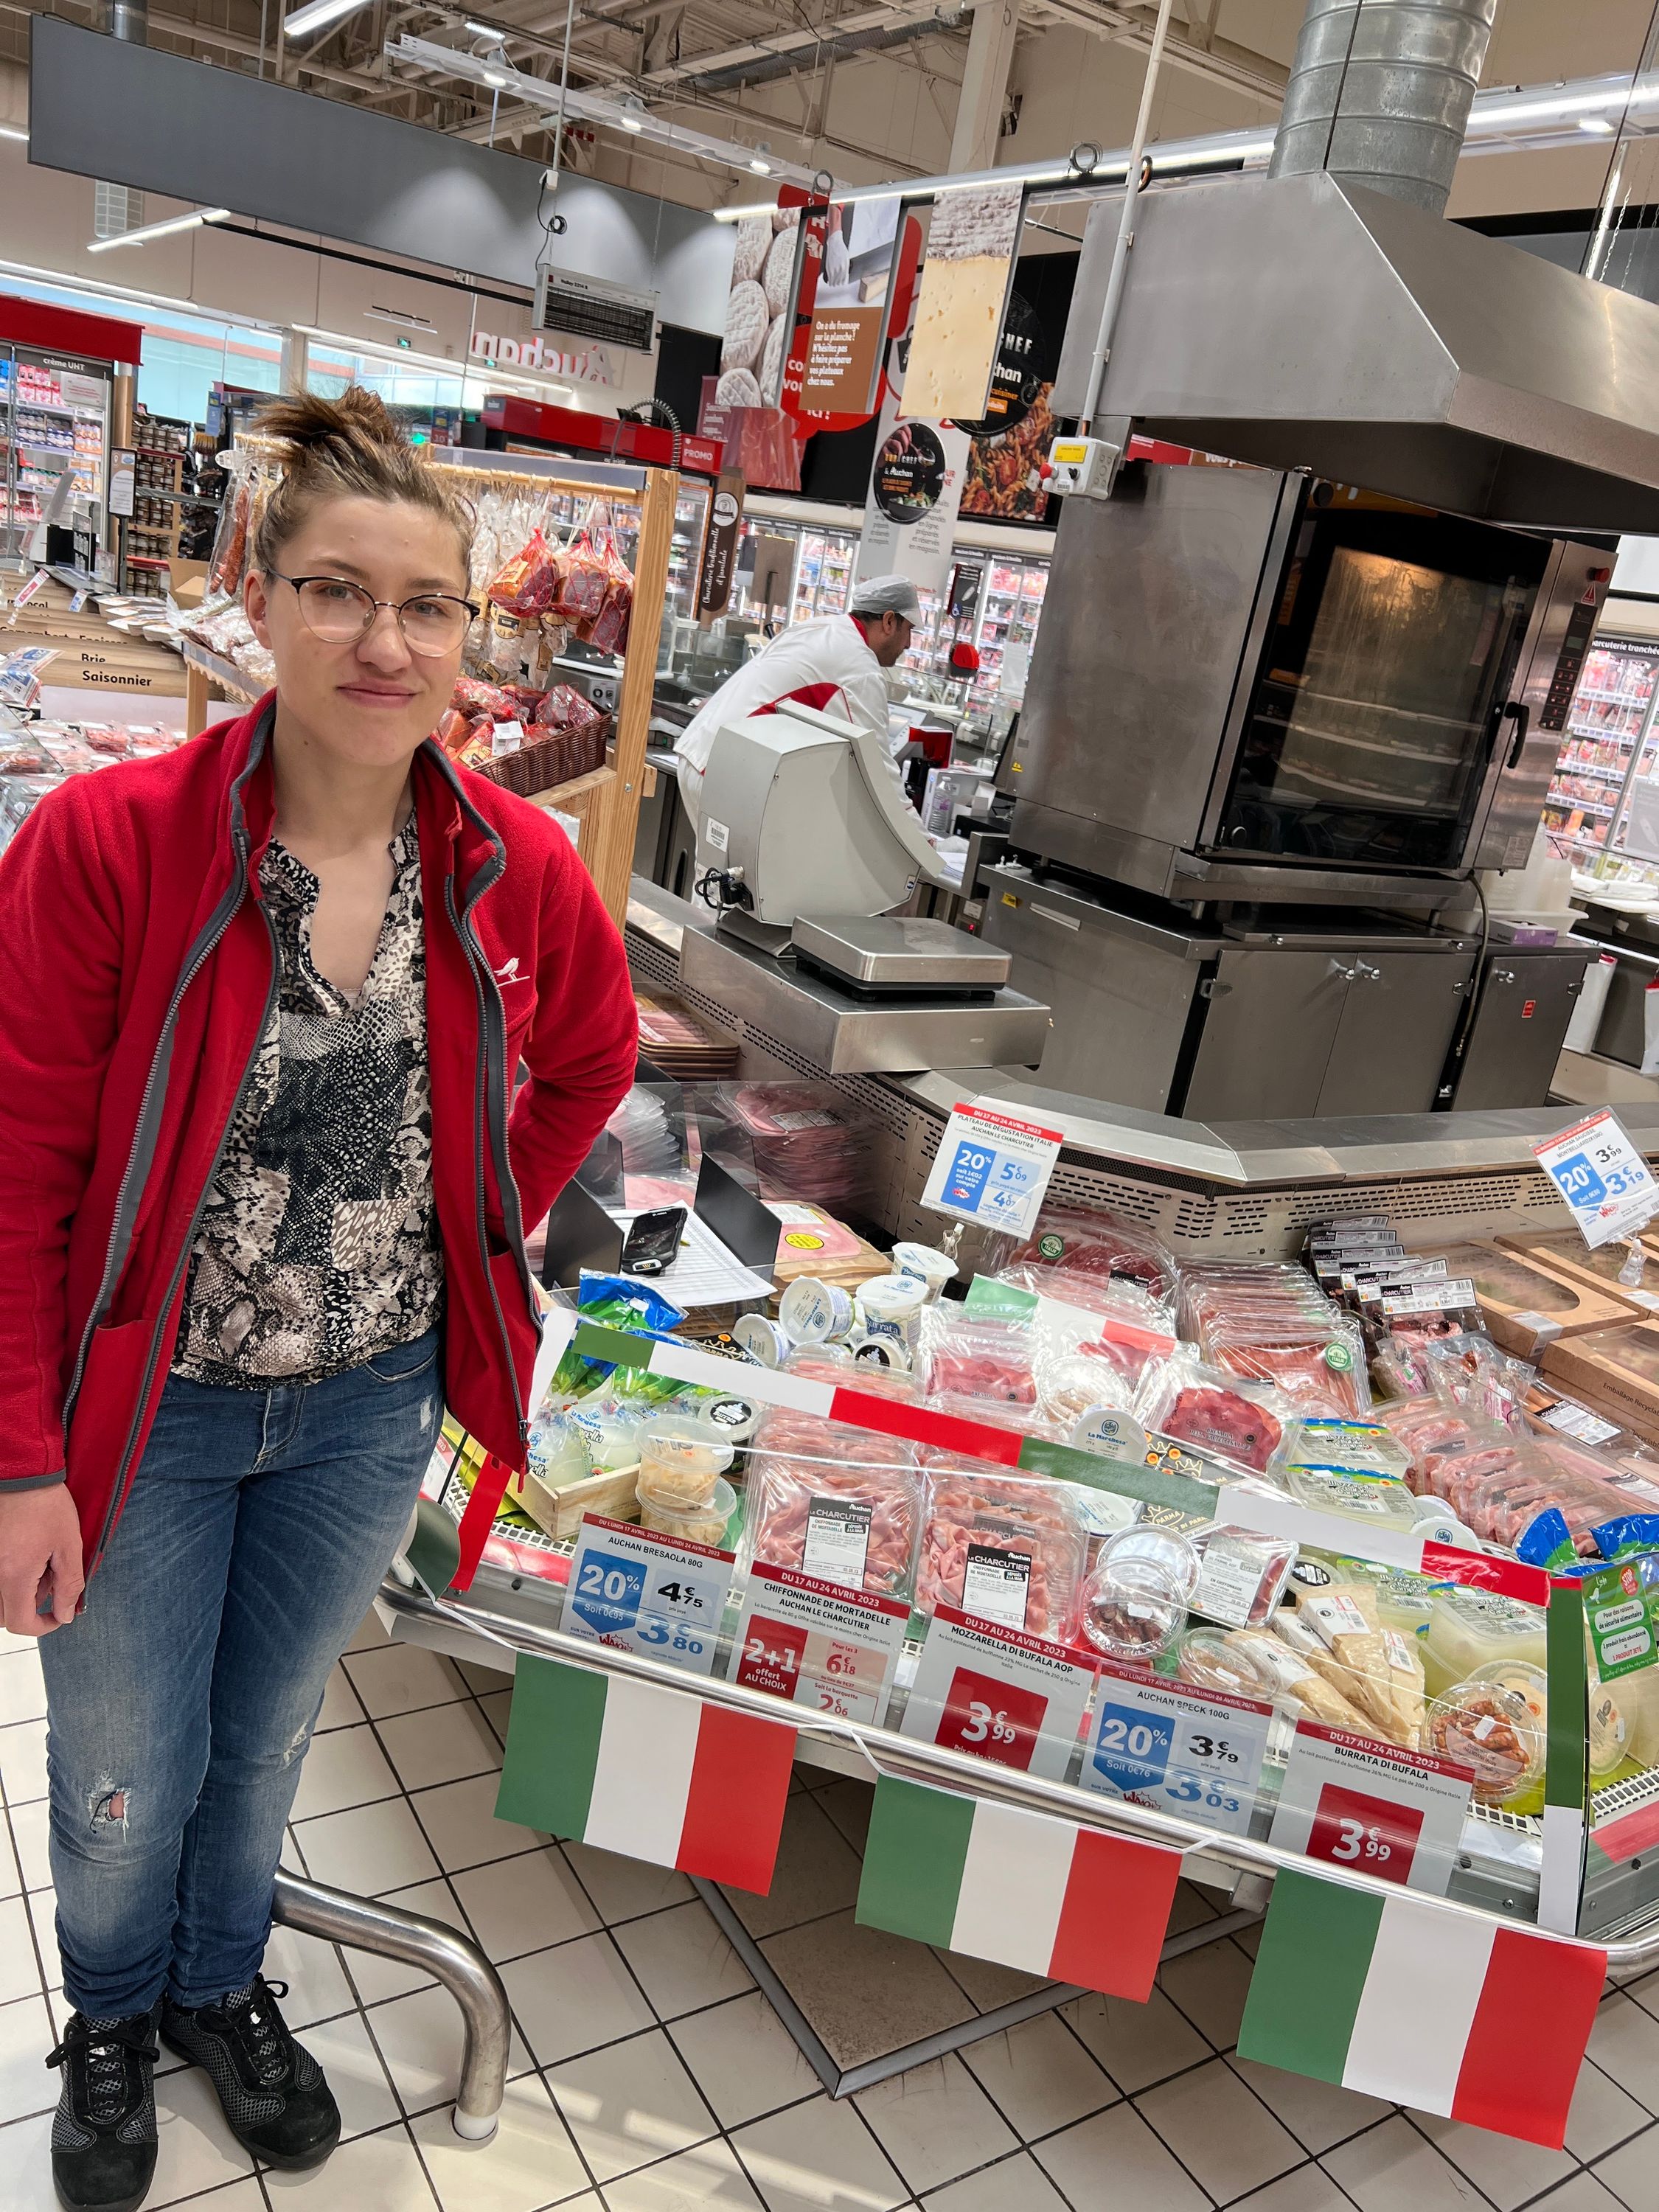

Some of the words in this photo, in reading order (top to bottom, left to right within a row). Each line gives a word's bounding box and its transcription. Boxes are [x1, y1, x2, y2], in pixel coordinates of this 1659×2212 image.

[837, 321, 860, 332] fromage
[43, 358, 66, 368] crème
[68, 362, 86, 371] UHT
[828, 355, 852, 366] préparer
[818, 366, 844, 376] plateaux
[684, 448, 713, 462] PROMO
[889, 466, 913, 478] Auchan
[702, 564, 714, 604] Charcuterie
[709, 527, 720, 564] traditionnelle
[83, 670, 152, 686] Saisonnier
[957, 1114, 986, 1126] PLATEAU
[1034, 1137, 1052, 1147] ITALIE
[1007, 1120, 1025, 1130] AVRIL
[1026, 1125, 1041, 1134] 2023
[971, 1126, 994, 1135] AUCHAN
[1001, 1135, 1034, 1148] CHARCUTIER
[1603, 1382, 1634, 1402] Emballage
[1096, 1434, 1127, 1445] Marchesa
[816, 1509, 870, 1523] CHARCUTIER
[849, 1504, 872, 1513] Auchan
[607, 1521, 623, 1529] LUNDI
[630, 1528, 645, 1536] AVRIL
[667, 1537, 684, 1546] LUNDI
[691, 1545, 706, 1553] AVRIL
[707, 1548, 720, 1557] 2023
[608, 1537, 641, 1551] AUCHAN
[643, 1545, 685, 1563] BRESAOLA
[687, 1558, 702, 1568] 80G
[1008, 1552, 1031, 1562] Auchan
[975, 1556, 1029, 1571] CHARCUTIER
[580, 1565, 639, 1599] 20%
[781, 1572, 793, 1582] DU
[794, 1576, 804, 1585] 17
[805, 1579, 818, 1588] AU
[818, 1583, 830, 1593] 24
[831, 1587, 855, 1600] AVRIL
[857, 1594, 879, 1607] 2023
[584, 1601, 602, 1614] Soit
[764, 1582, 821, 1605] CHIFFONNADE
[823, 1599, 834, 1609] DE
[835, 1603, 890, 1625] MORTADELLE
[1619, 1604, 1634, 1613] raisons
[779, 1599, 811, 1613] AUCHAN
[812, 1607, 821, 1615] LE
[822, 1611, 869, 1630] CHARCUTIER
[1604, 1618, 1619, 1627] sécurité
[1619, 1611, 1641, 1622] alimentaire
[832, 1641, 844, 1649] Pour
[964, 1616, 978, 1627] DU
[978, 1621, 989, 1630] 17
[990, 1626, 1004, 1635] AU
[1004, 1630, 1015, 1641] 24
[1016, 1635, 1041, 1649] AVRIL
[1043, 1644, 1065, 1658] 2023
[1605, 1639, 1618, 1648] produit
[745, 1638, 797, 1672] 2+1
[951, 1626, 1006, 1651] MOZZARELLA
[1009, 1646, 1018, 1655] DI
[1018, 1649, 1051, 1666] BUFALA
[1054, 1662, 1073, 1672] AOP
[1615, 1649, 1632, 1660] PRODUIT
[953, 1639, 975, 1649] pasteurisé
[1063, 1677, 1080, 1686] Origine
[745, 1672, 758, 1681] AU
[759, 1677, 786, 1691] CHOIX
[755, 1668, 779, 1680] offert
[814, 1682, 825, 1690] Soit
[832, 1688, 858, 1700] barquette
[1128, 1672, 1147, 1682] LUNDI
[1155, 1679, 1172, 1688] AVRIL
[1196, 1689, 1214, 1699] LUNDI
[1222, 1697, 1240, 1706] AVRIL
[1137, 1691, 1174, 1705] AUCHAN
[1177, 1700, 1206, 1714] SPECK
[1208, 1708, 1229, 1719] 100G
[1101, 1719, 1166, 1756] 20%
[1329, 1731, 1343, 1741] DU
[1344, 1735, 1355, 1744] 17
[1357, 1739, 1371, 1749] AU
[1371, 1743, 1384, 1753] 24
[1385, 1747, 1413, 1761] AVRIL
[1415, 1756, 1439, 1769] 2023
[1106, 1758, 1126, 1770] Soit
[1127, 1764, 1150, 1777] 0€76
[1335, 1746, 1378, 1765] BURRATA
[1380, 1759, 1390, 1768] DI
[1391, 1763, 1427, 1780] BUFALA
[1429, 1787, 1447, 1795] Origine
